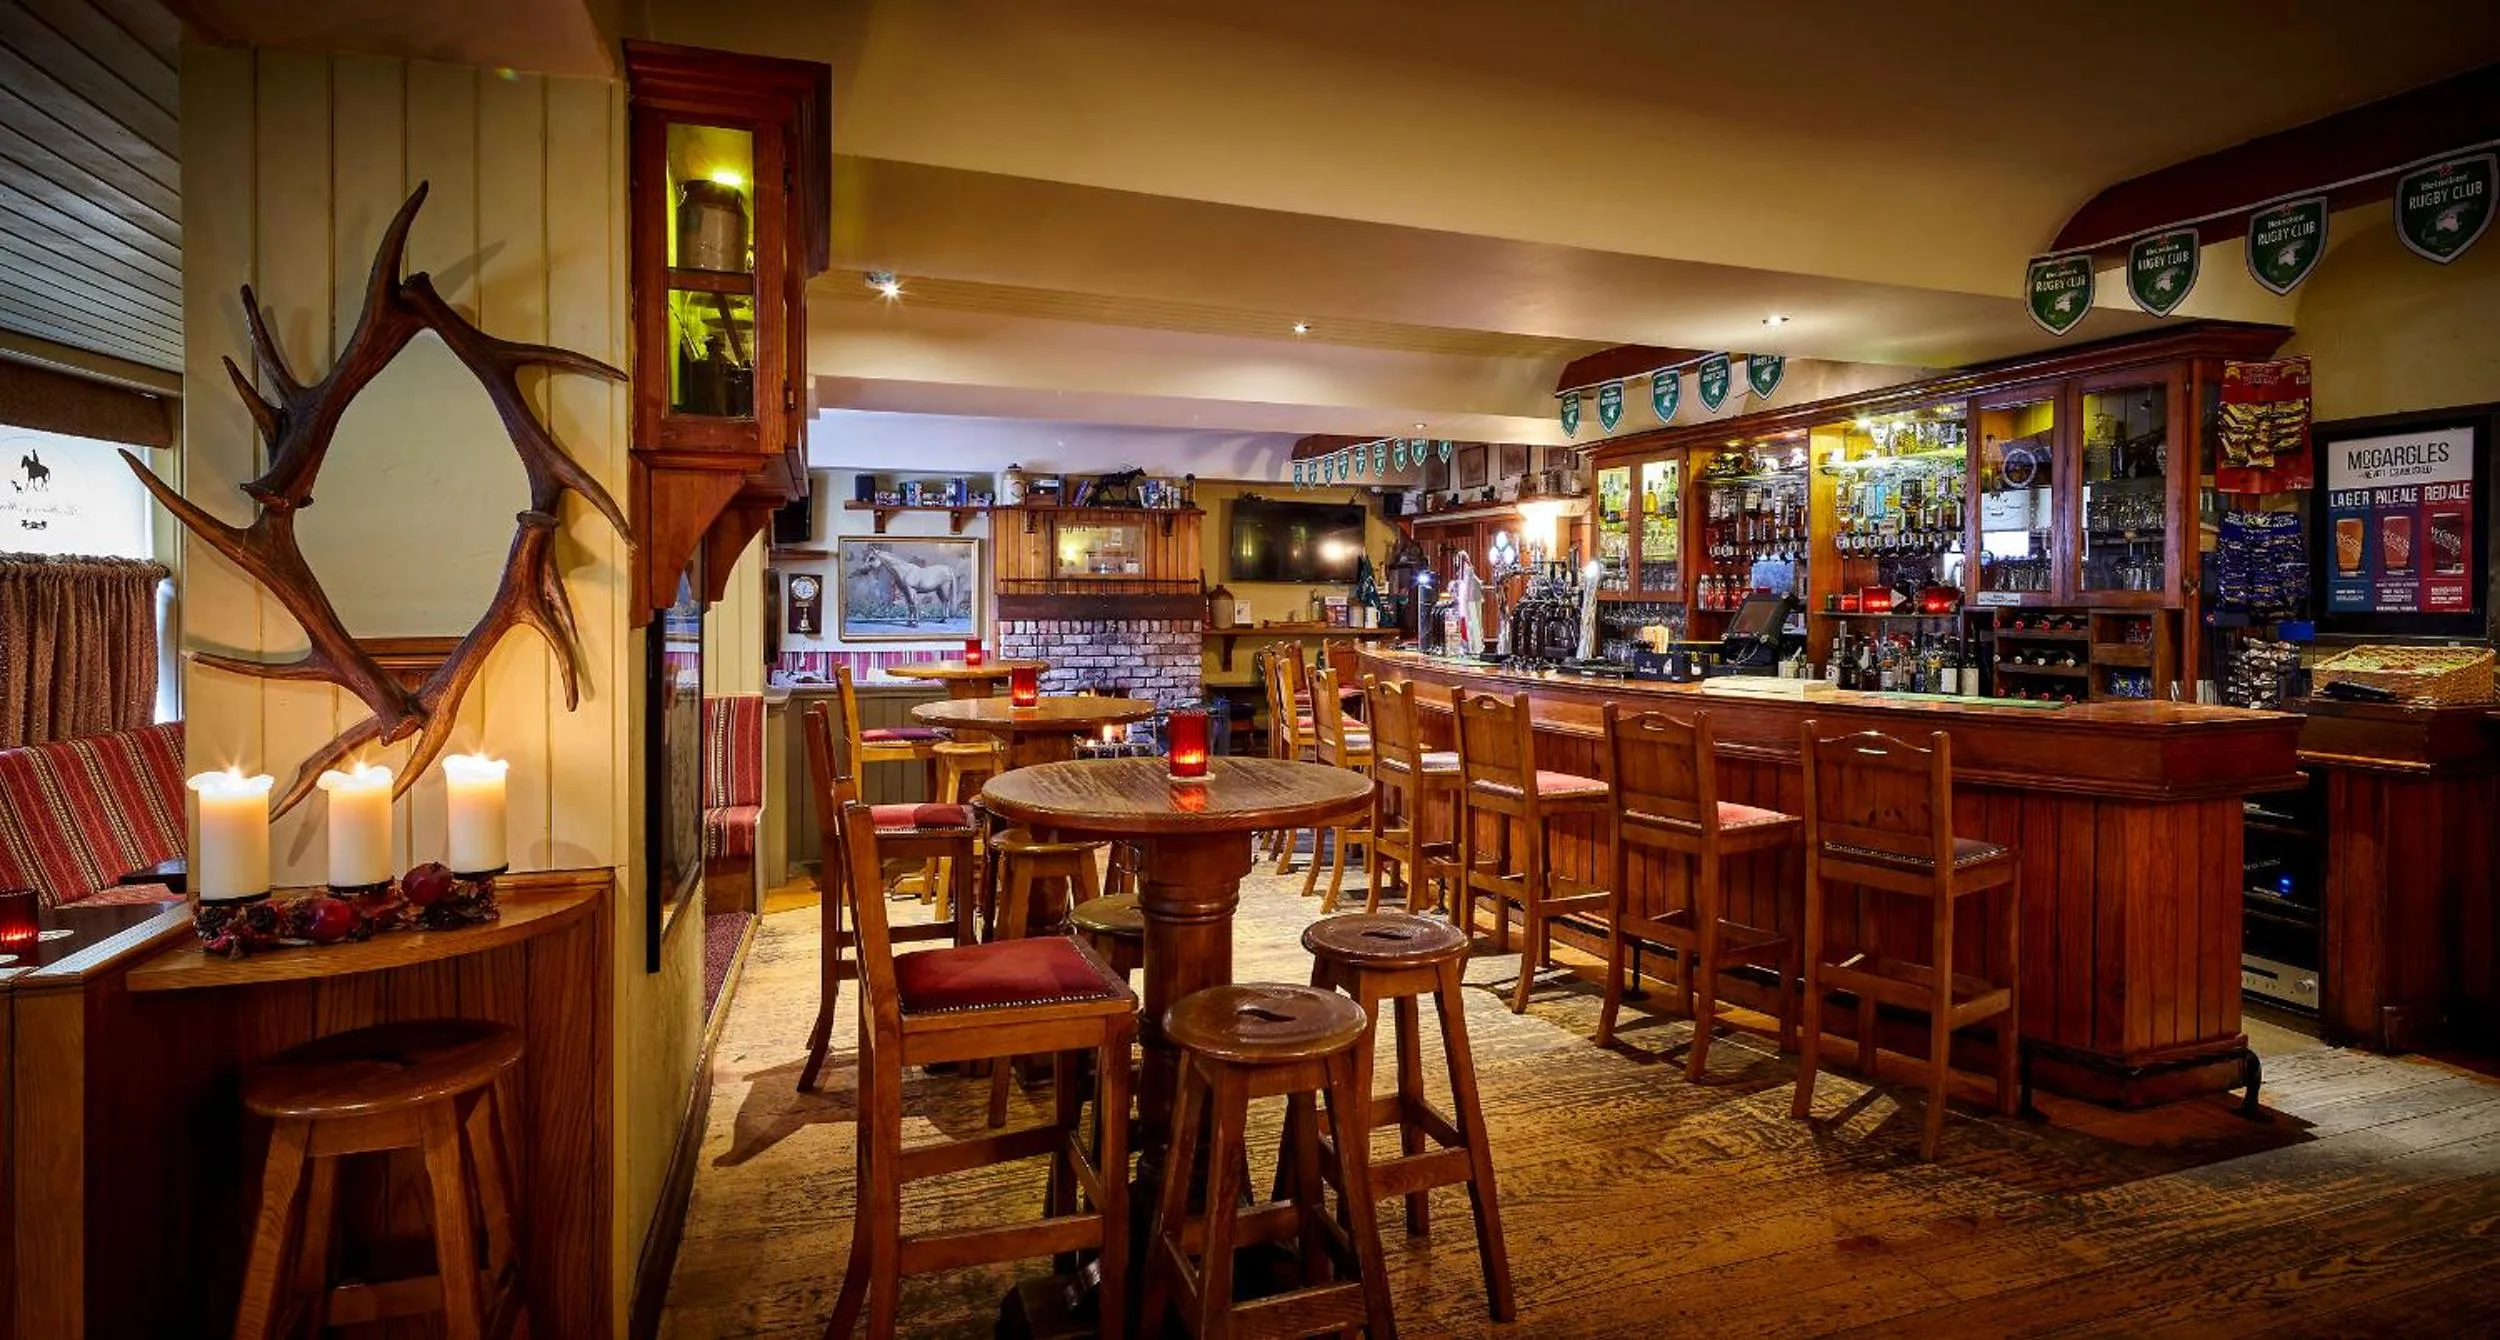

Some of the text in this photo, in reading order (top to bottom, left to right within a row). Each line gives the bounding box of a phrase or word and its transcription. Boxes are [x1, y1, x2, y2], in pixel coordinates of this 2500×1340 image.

[2409, 181, 2483, 210] RUGBY CLUB
[2257, 221, 2316, 246] RUGBY CLUB
[2137, 251, 2190, 272] RUGBY CLUB
[2036, 275, 2086, 292] RUGBY CLUB
[2330, 491, 2369, 508] LAGER
[2375, 487, 2418, 504] PALE ALE
[2424, 483, 2471, 501] RED ALE
